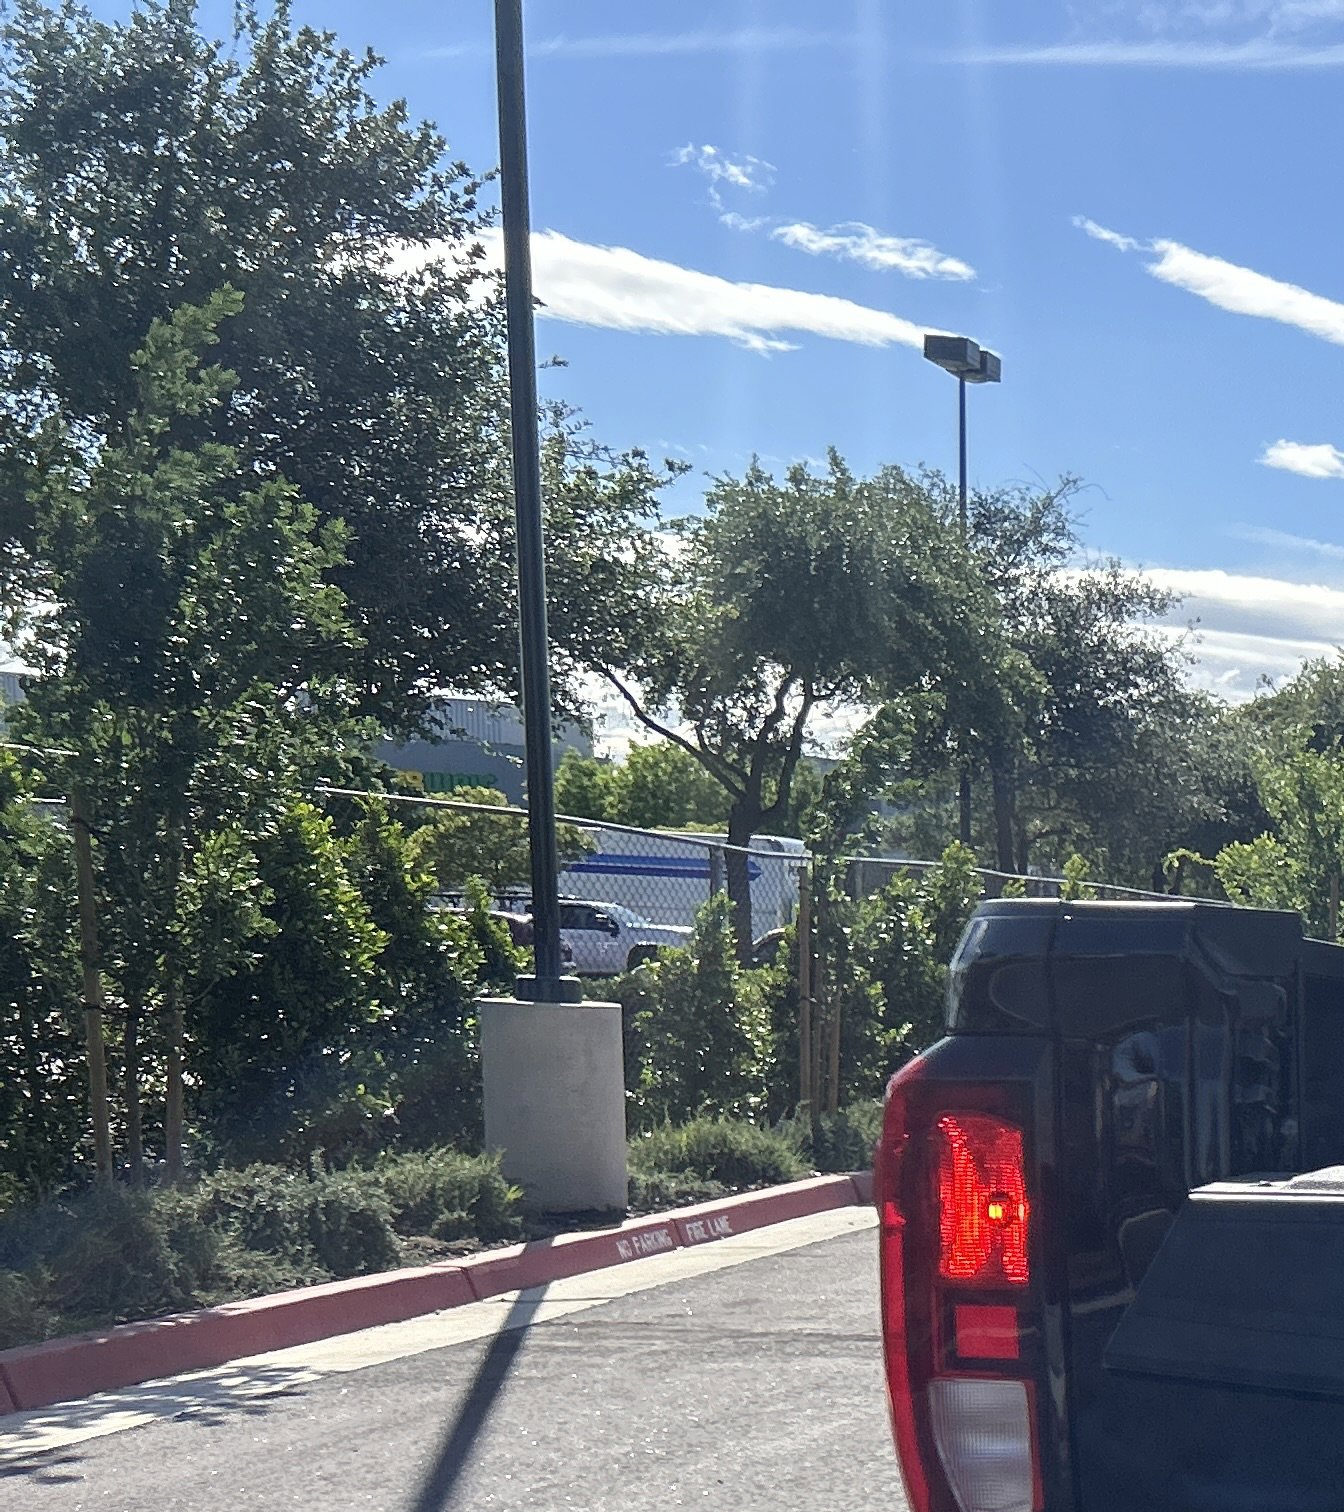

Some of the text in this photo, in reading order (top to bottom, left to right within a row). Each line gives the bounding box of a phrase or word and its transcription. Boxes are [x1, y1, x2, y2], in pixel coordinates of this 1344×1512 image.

[616, 1215, 733, 1259] NO PARKING FIRE LANE
